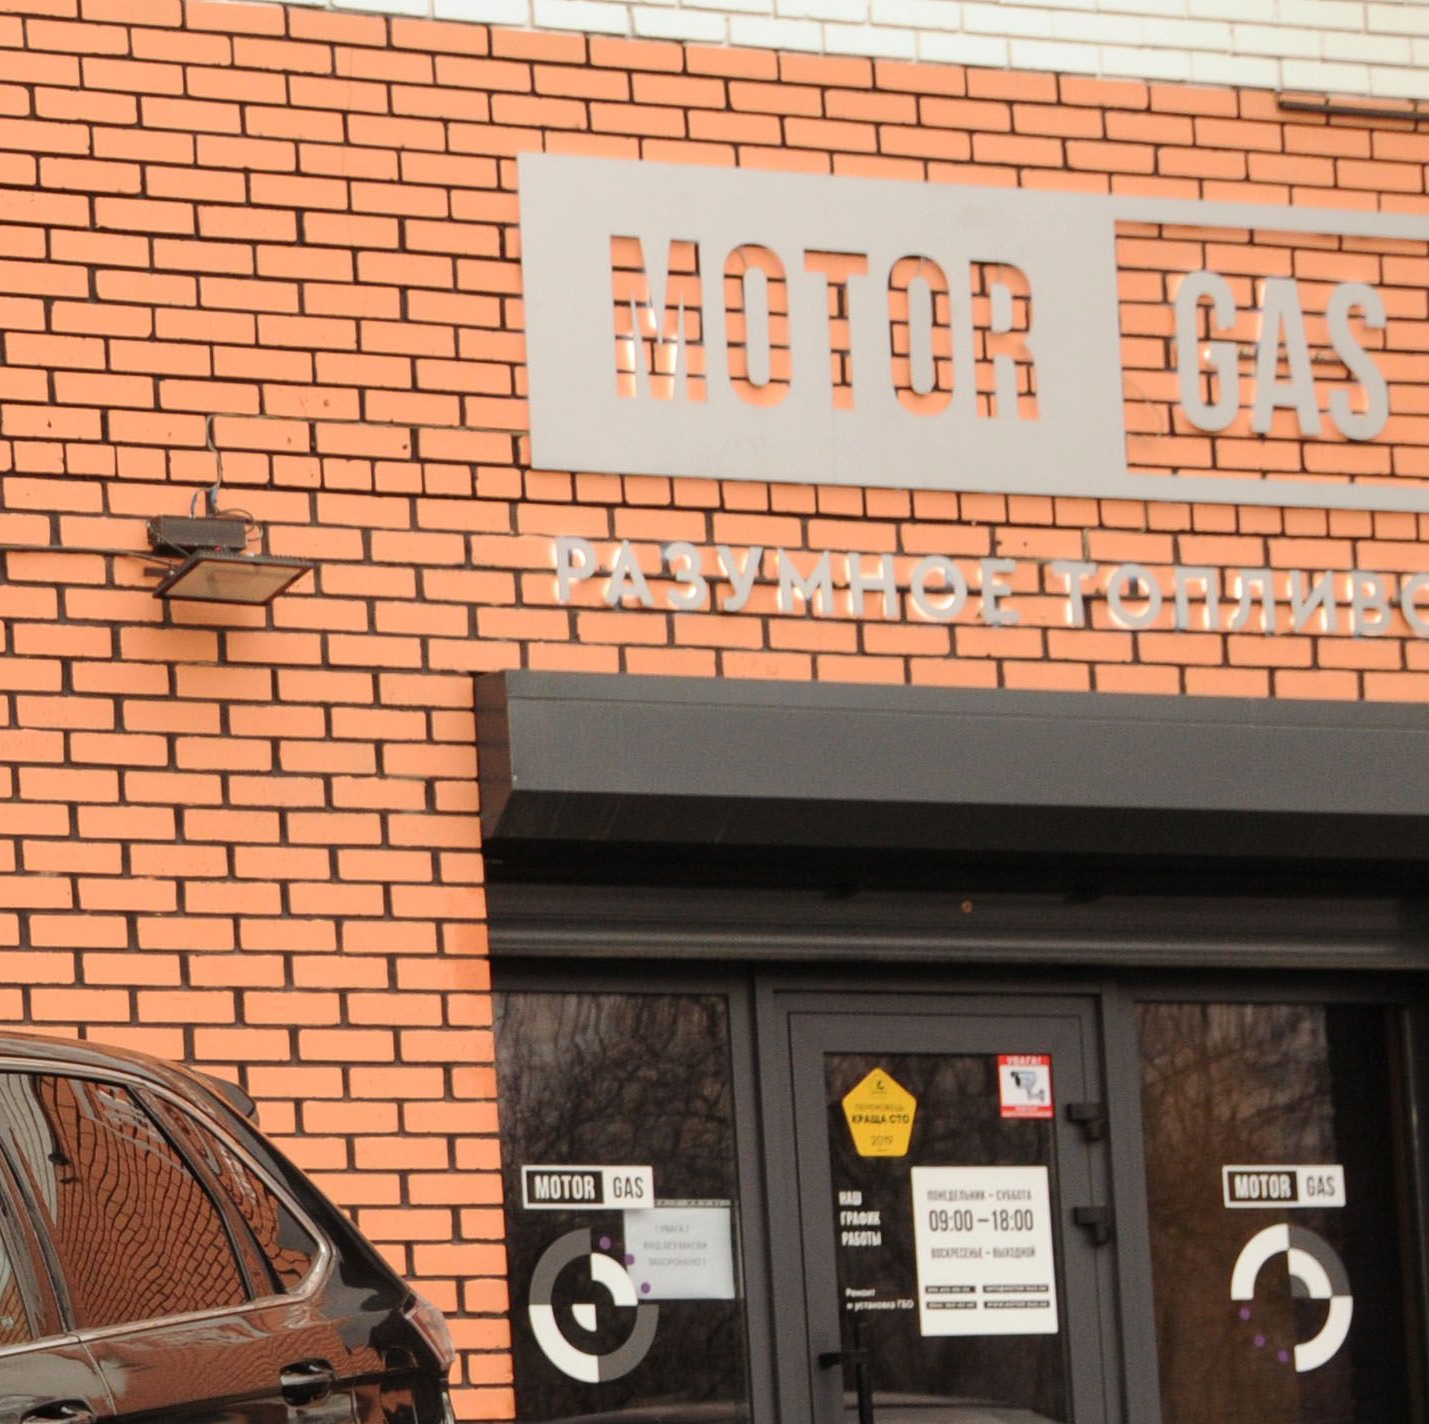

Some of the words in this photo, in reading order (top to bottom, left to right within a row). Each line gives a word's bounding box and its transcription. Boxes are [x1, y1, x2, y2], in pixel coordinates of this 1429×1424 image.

[610, 234, 1040, 421] MOTOR
[1174, 271, 1390, 441] GAS
[552, 535, 1020, 628] РАЗУМНОЕ
[534, 1175, 595, 1200] MOTOR
[613, 1176, 644, 1199] GAS
[996, 1189, 1032, 1201] СУББОТА
[1234, 1174, 1292, 1199] MOTOR
[1306, 1176, 1335, 1197] GAS
[840, 1210, 881, 1226] ГРАФИК
[929, 1209, 974, 1232] 09:00
[992, 1208, 1034, 1232] 18:00
[841, 1231, 882, 1247] РАБОТЫ
